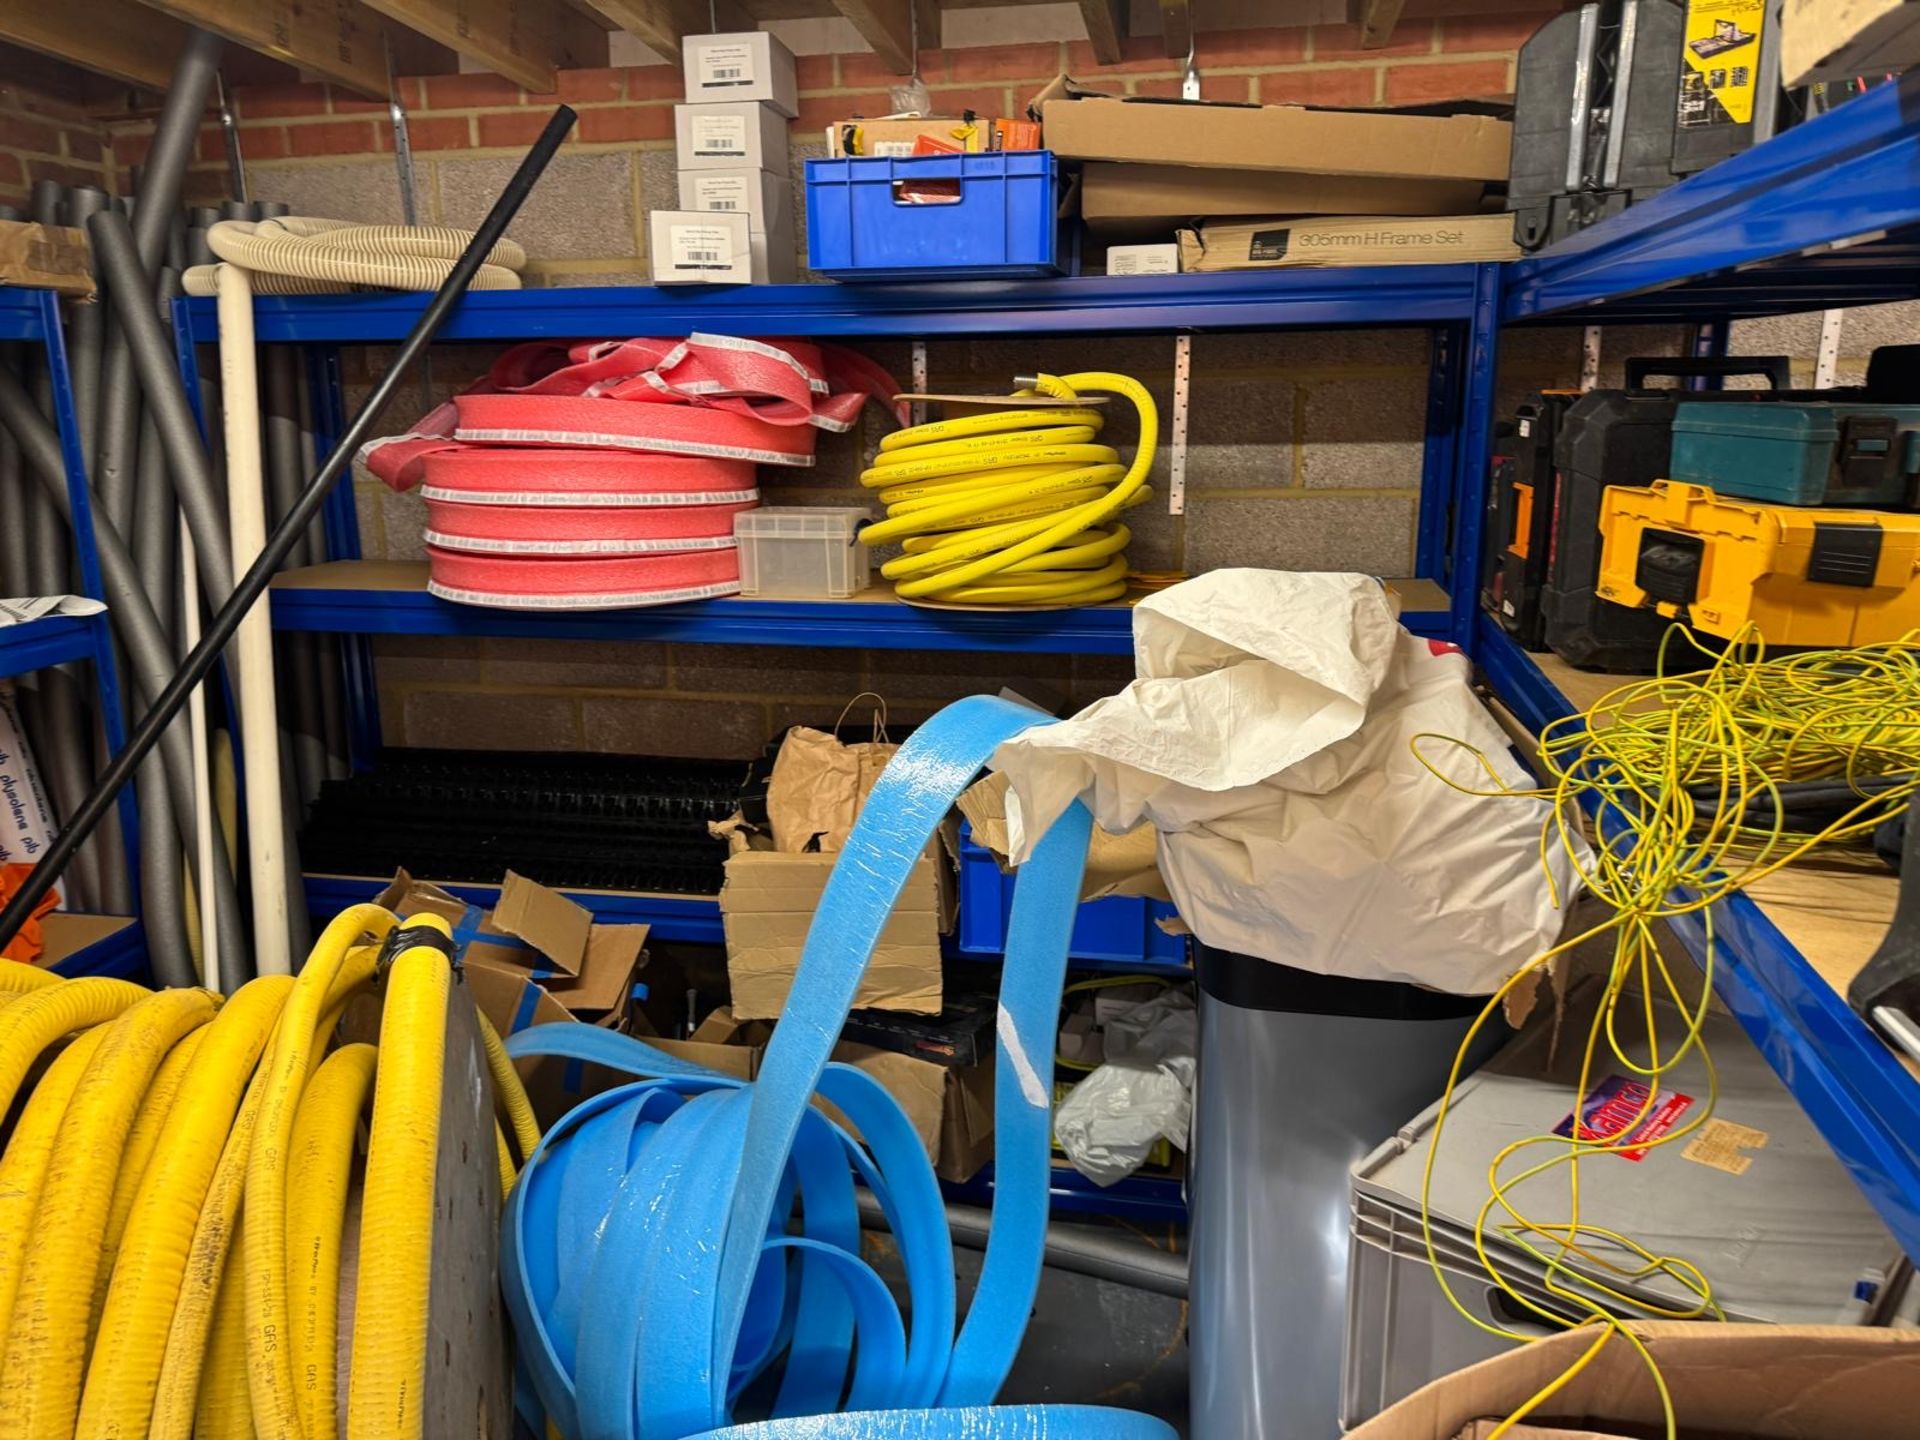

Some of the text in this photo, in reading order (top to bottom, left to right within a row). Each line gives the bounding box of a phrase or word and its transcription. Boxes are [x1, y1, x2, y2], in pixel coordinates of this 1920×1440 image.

[1300, 230, 1464, 247] 305mm H Frame Set
